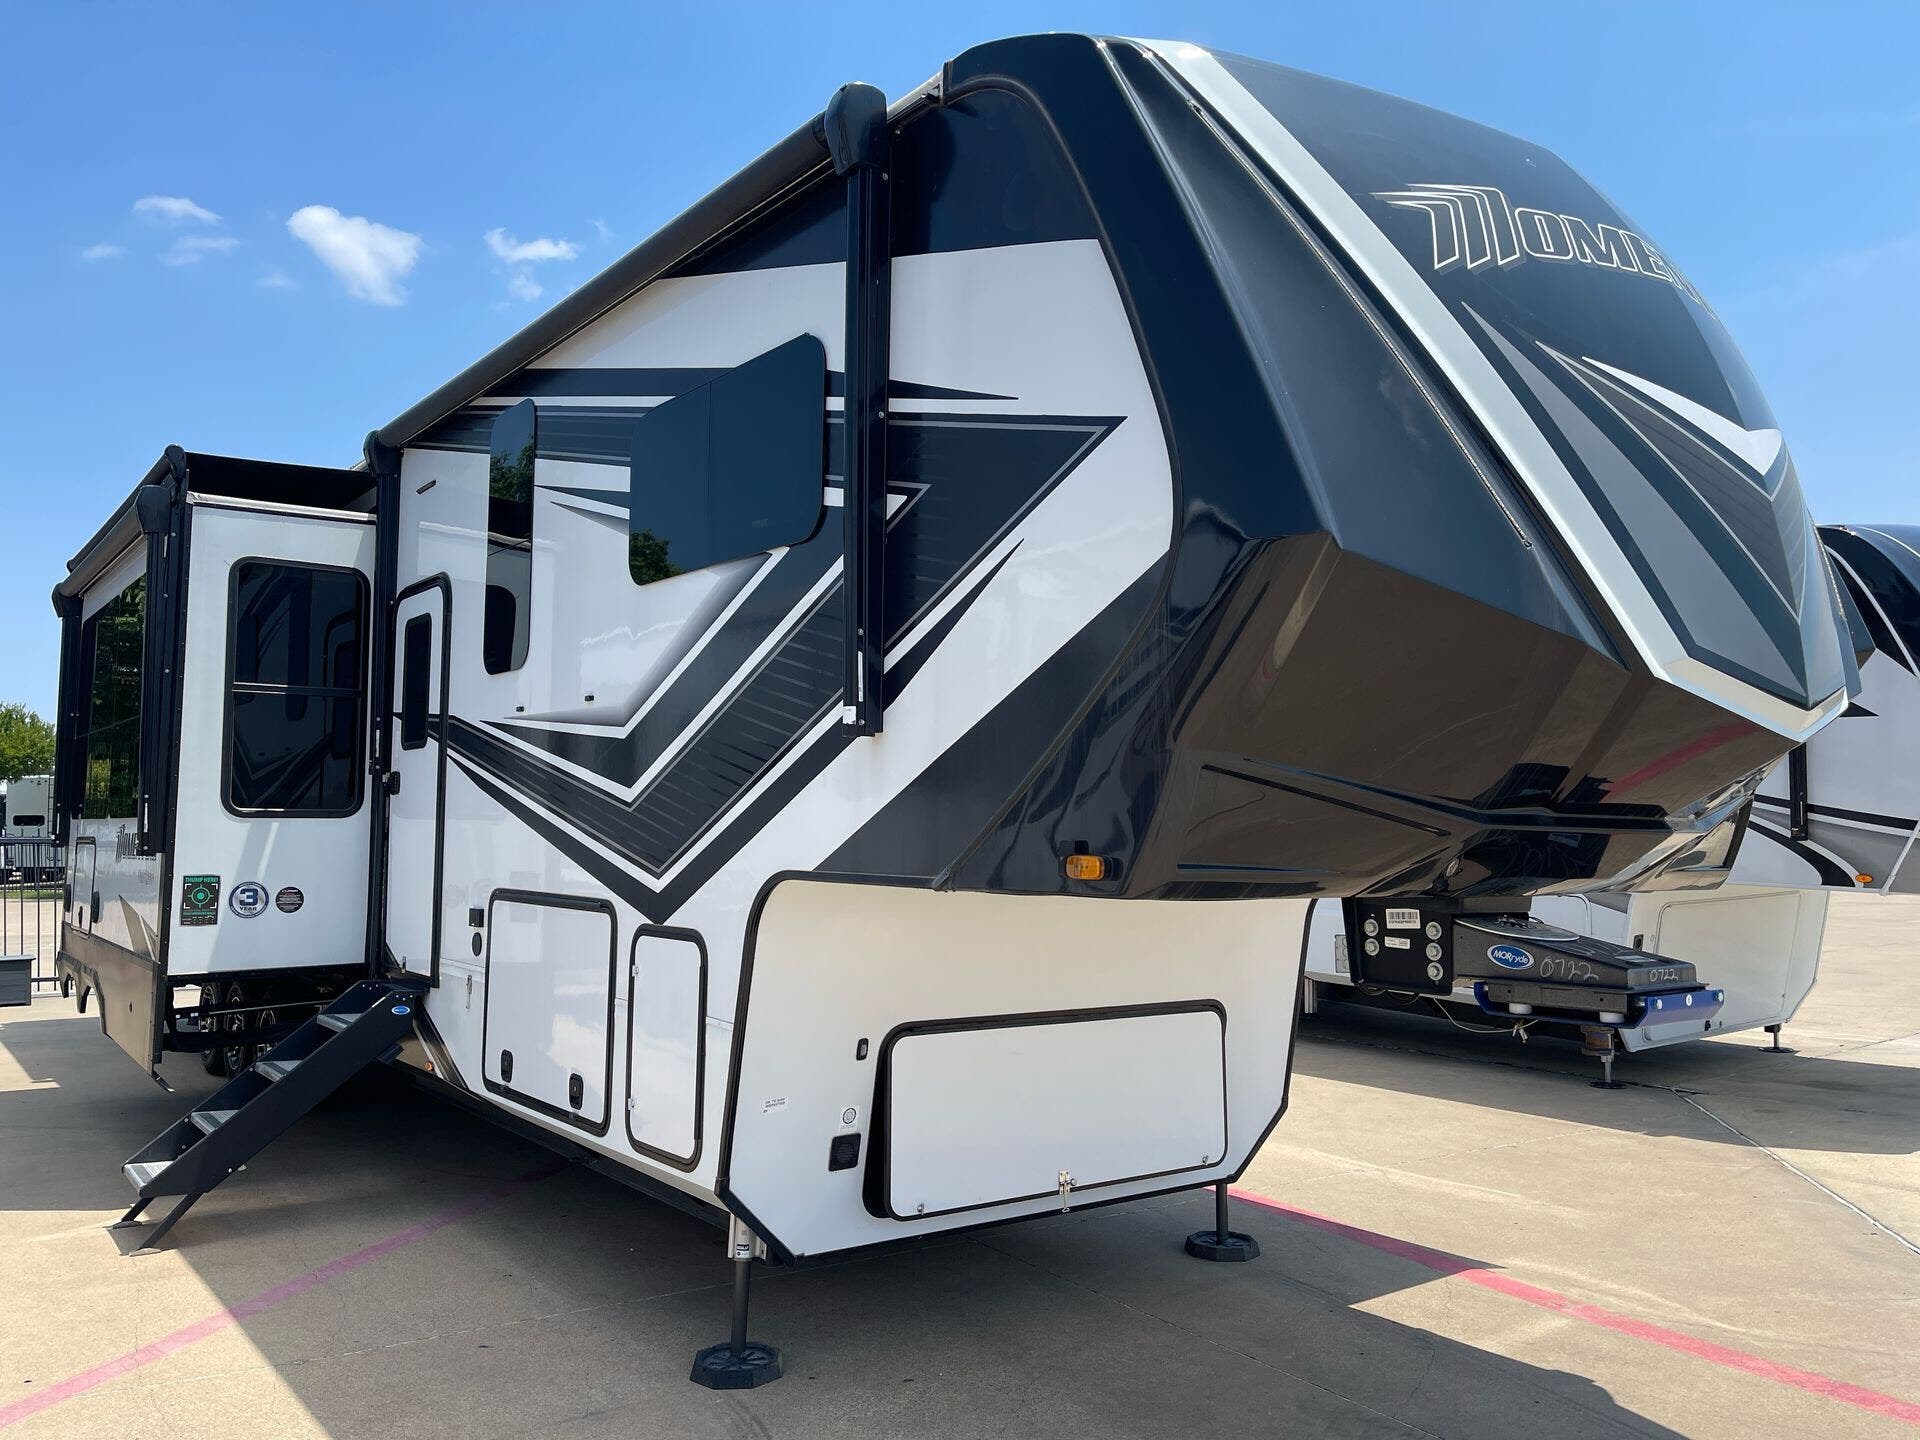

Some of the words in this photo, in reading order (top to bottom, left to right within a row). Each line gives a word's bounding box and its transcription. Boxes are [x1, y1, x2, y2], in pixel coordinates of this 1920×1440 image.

[239, 888, 259, 906] 3
[1492, 949, 1529, 964] MORryde
[1540, 956, 1599, 981] 0722
[1650, 969, 1679, 982] 0722
